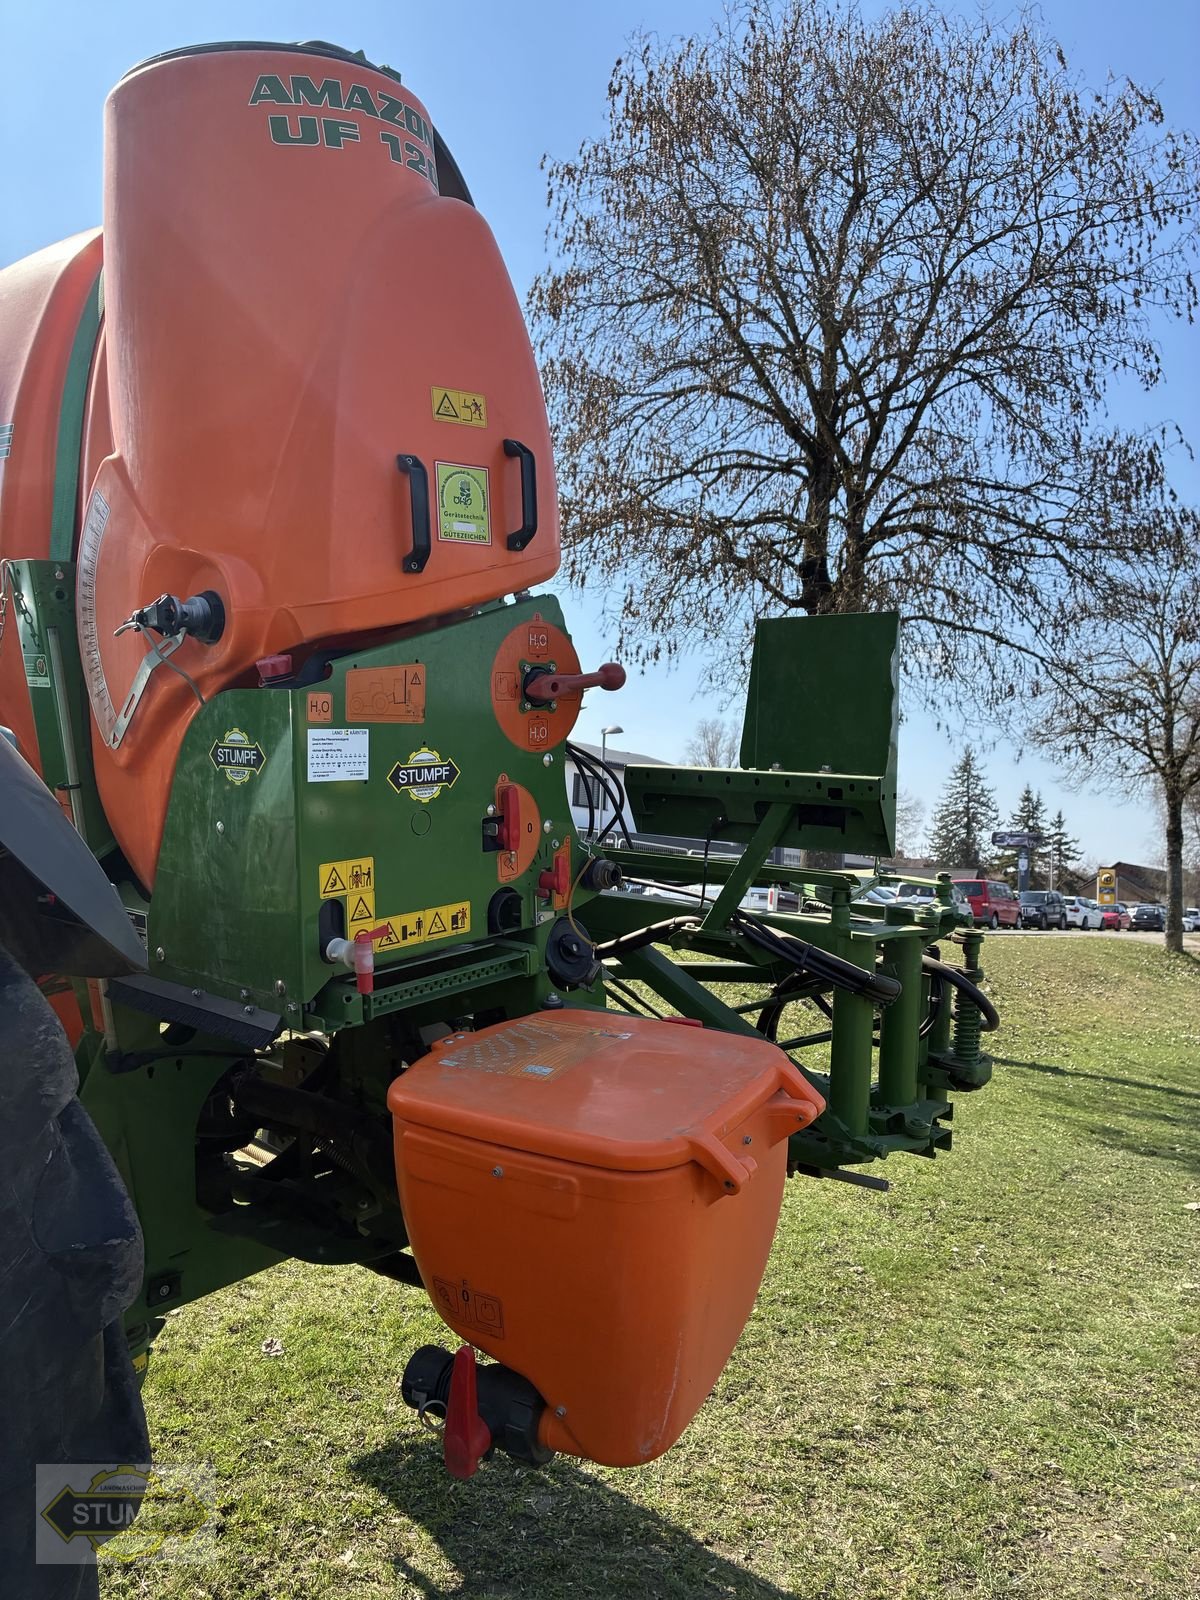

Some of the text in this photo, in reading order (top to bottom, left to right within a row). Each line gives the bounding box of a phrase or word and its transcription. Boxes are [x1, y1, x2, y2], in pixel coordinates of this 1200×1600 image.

[268, 115, 360, 149] UF
[443, 510, 485, 520] Gerätetechnik
[443, 531, 488, 541] GÜTEZEICHEN
[217, 748, 257, 765] STUMPF
[398, 766, 451, 784] STUMPF
